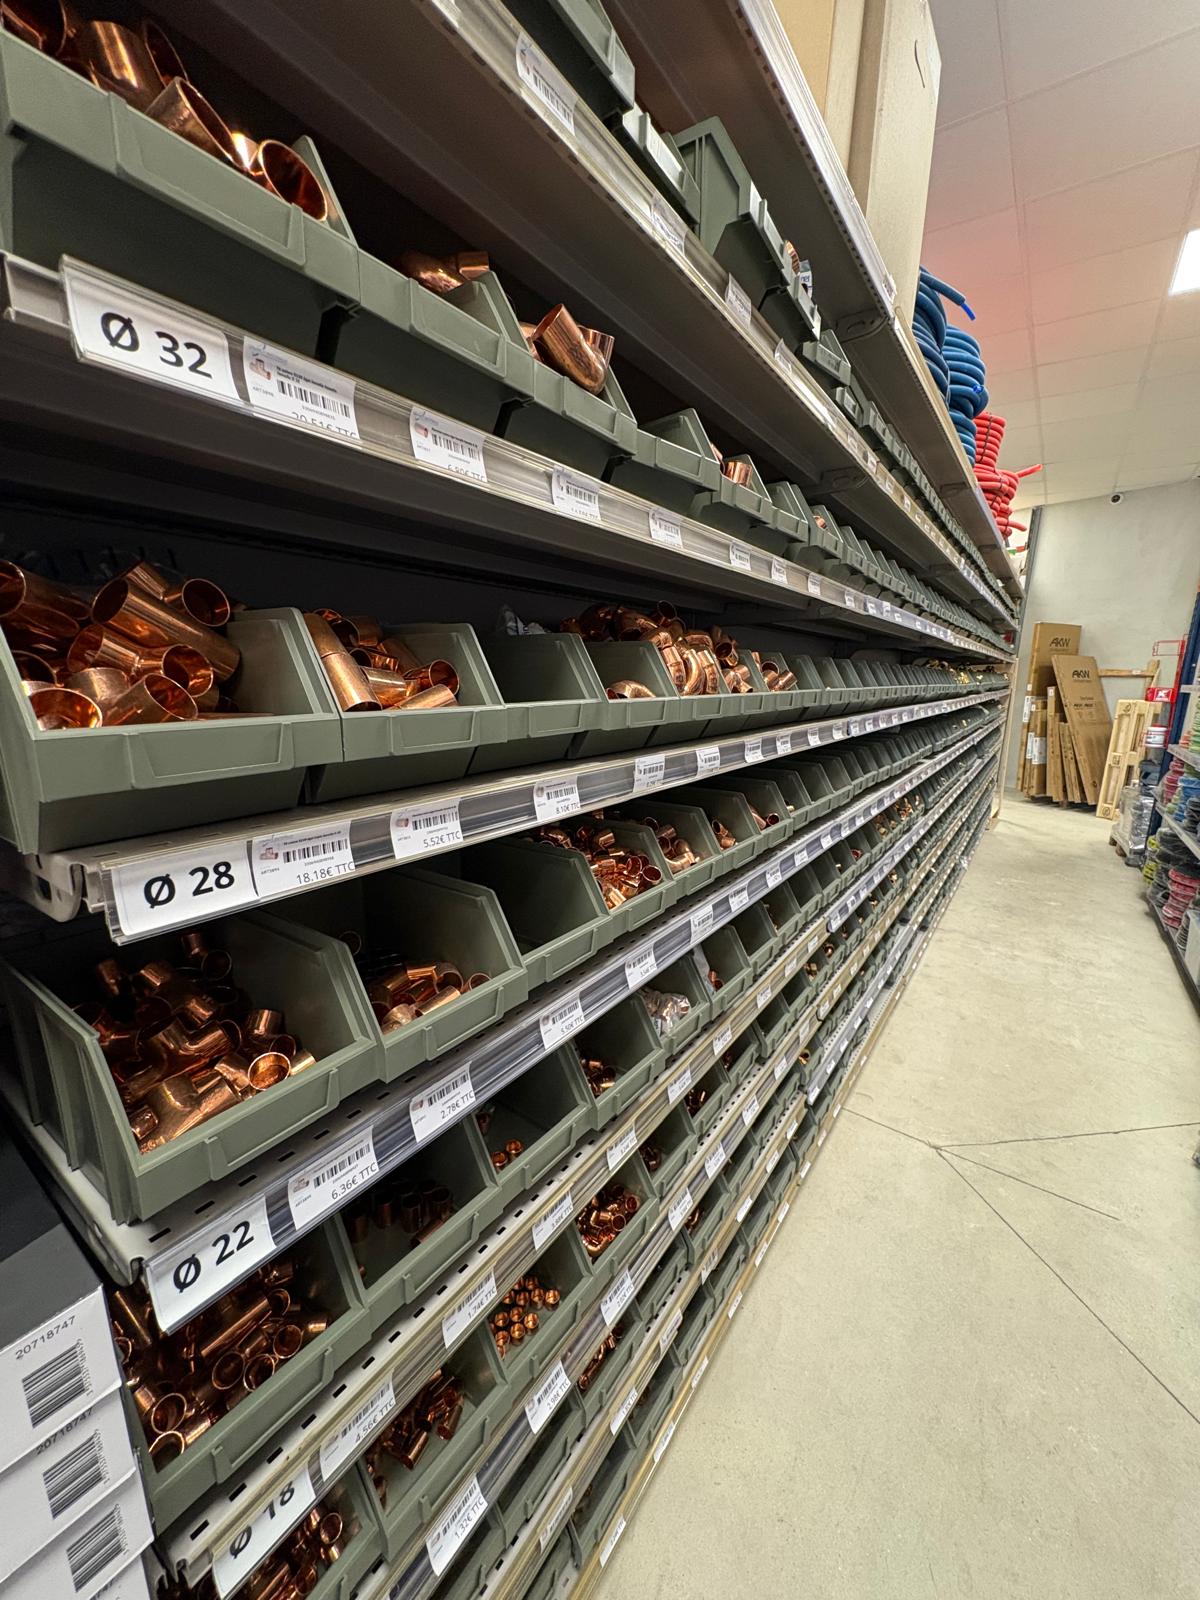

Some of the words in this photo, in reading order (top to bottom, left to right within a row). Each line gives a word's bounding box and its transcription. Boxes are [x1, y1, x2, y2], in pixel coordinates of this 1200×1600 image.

[101, 312, 139, 352] Ø
[155, 331, 213, 379] 32
[1050, 637, 1071, 647] AKW
[1072, 669, 1090, 679] AKW
[423, 836, 446, 848] 5.52€
[447, 830, 460, 842] TTC
[143, 873, 176, 908] Ø
[189, 861, 235, 896] 28
[296, 866, 334, 884] 18.18€
[335, 861, 355, 874] TTC
[440, 1101, 460, 1119] 2.78€
[461, 1089, 475, 1104] TTC
[331, 1174, 358, 1200] 6.36€
[360, 1161, 377, 1180] TTC
[173, 1253, 202, 1293] Ø
[212, 1220, 255, 1266] 22
[485, 1286, 495, 1300] TTC
[15, 1315, 76, 1360] 20718747
[560, 1378, 570, 1392] TTC
[355, 1414, 378, 1443] 4.56€
[379, 1397, 394, 1416] TTC
[229, 1525, 252, 1559] Ø
[262, 1481, 295, 1520] 18
[454, 1512, 473, 1539] 1.32€
[472, 1496, 484, 1515] TTC
